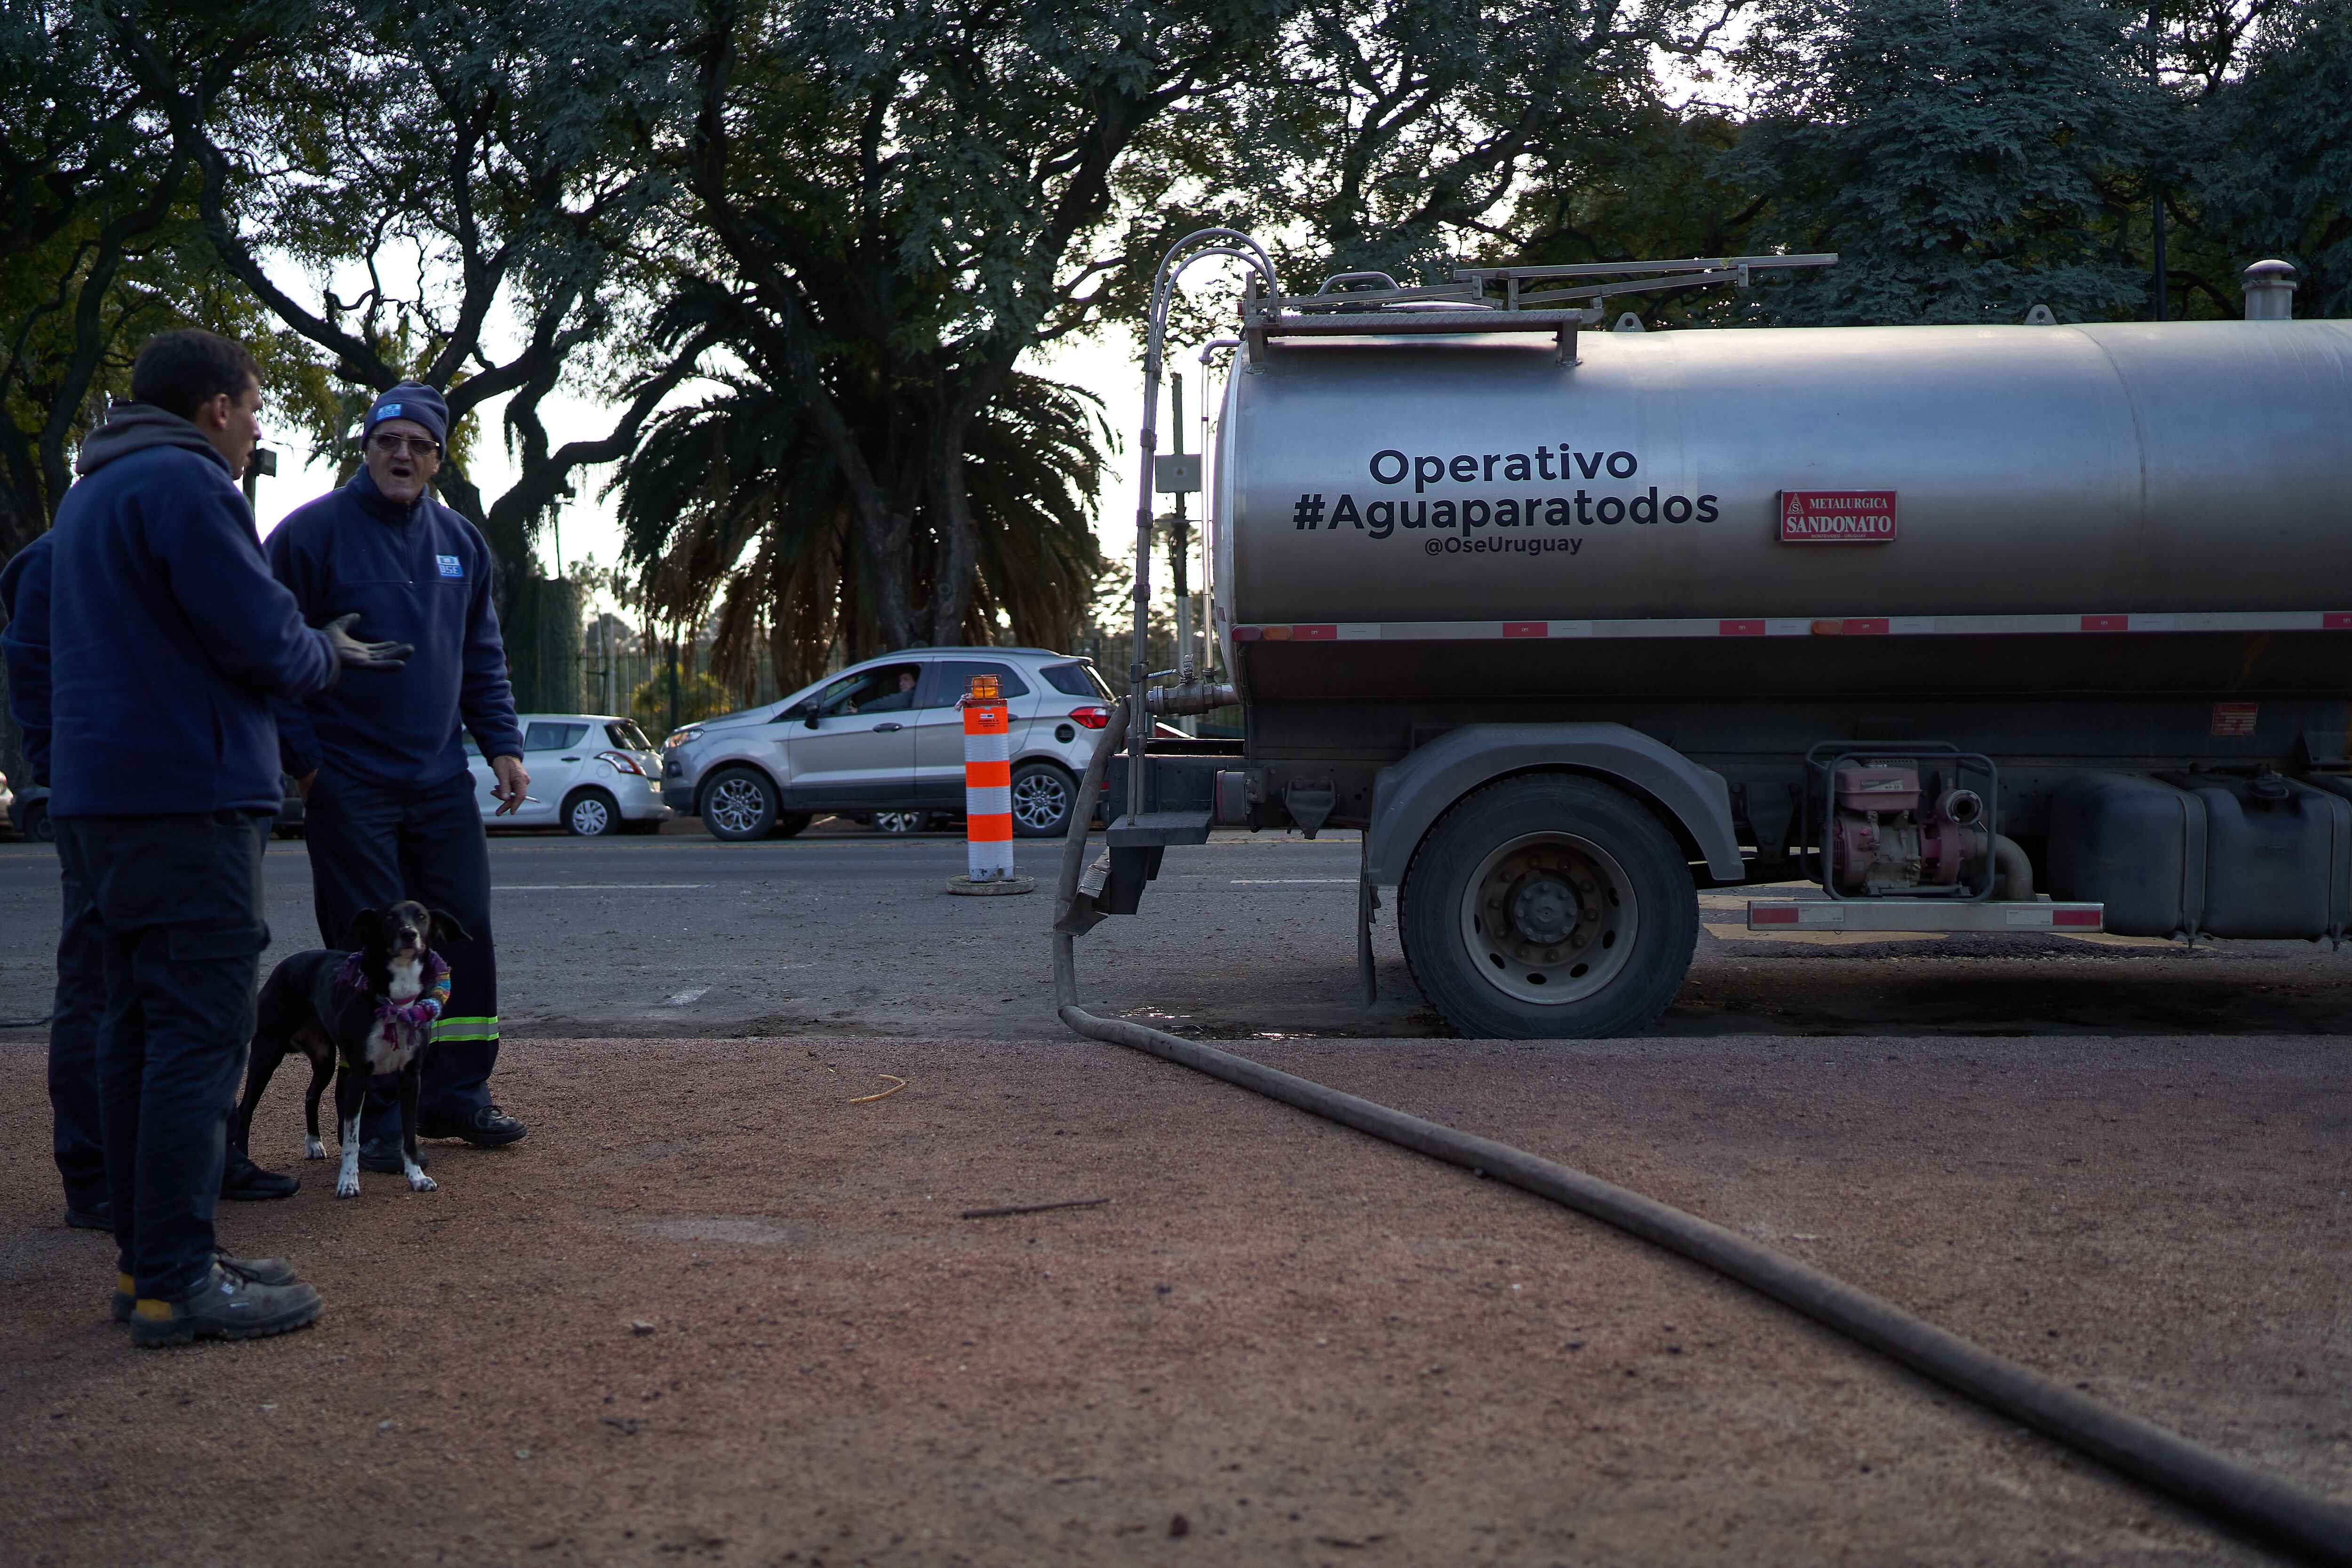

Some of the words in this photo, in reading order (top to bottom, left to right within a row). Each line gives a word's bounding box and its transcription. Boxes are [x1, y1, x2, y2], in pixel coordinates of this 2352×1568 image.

[1369, 443, 1637, 493] Operativo
[1293, 486, 1719, 539] #Aguaparatodos
[1809, 498, 1887, 509] METALURGICA
[1786, 516, 1891, 533] SANDONATO
[1425, 536, 1582, 556] @OseUruguay
